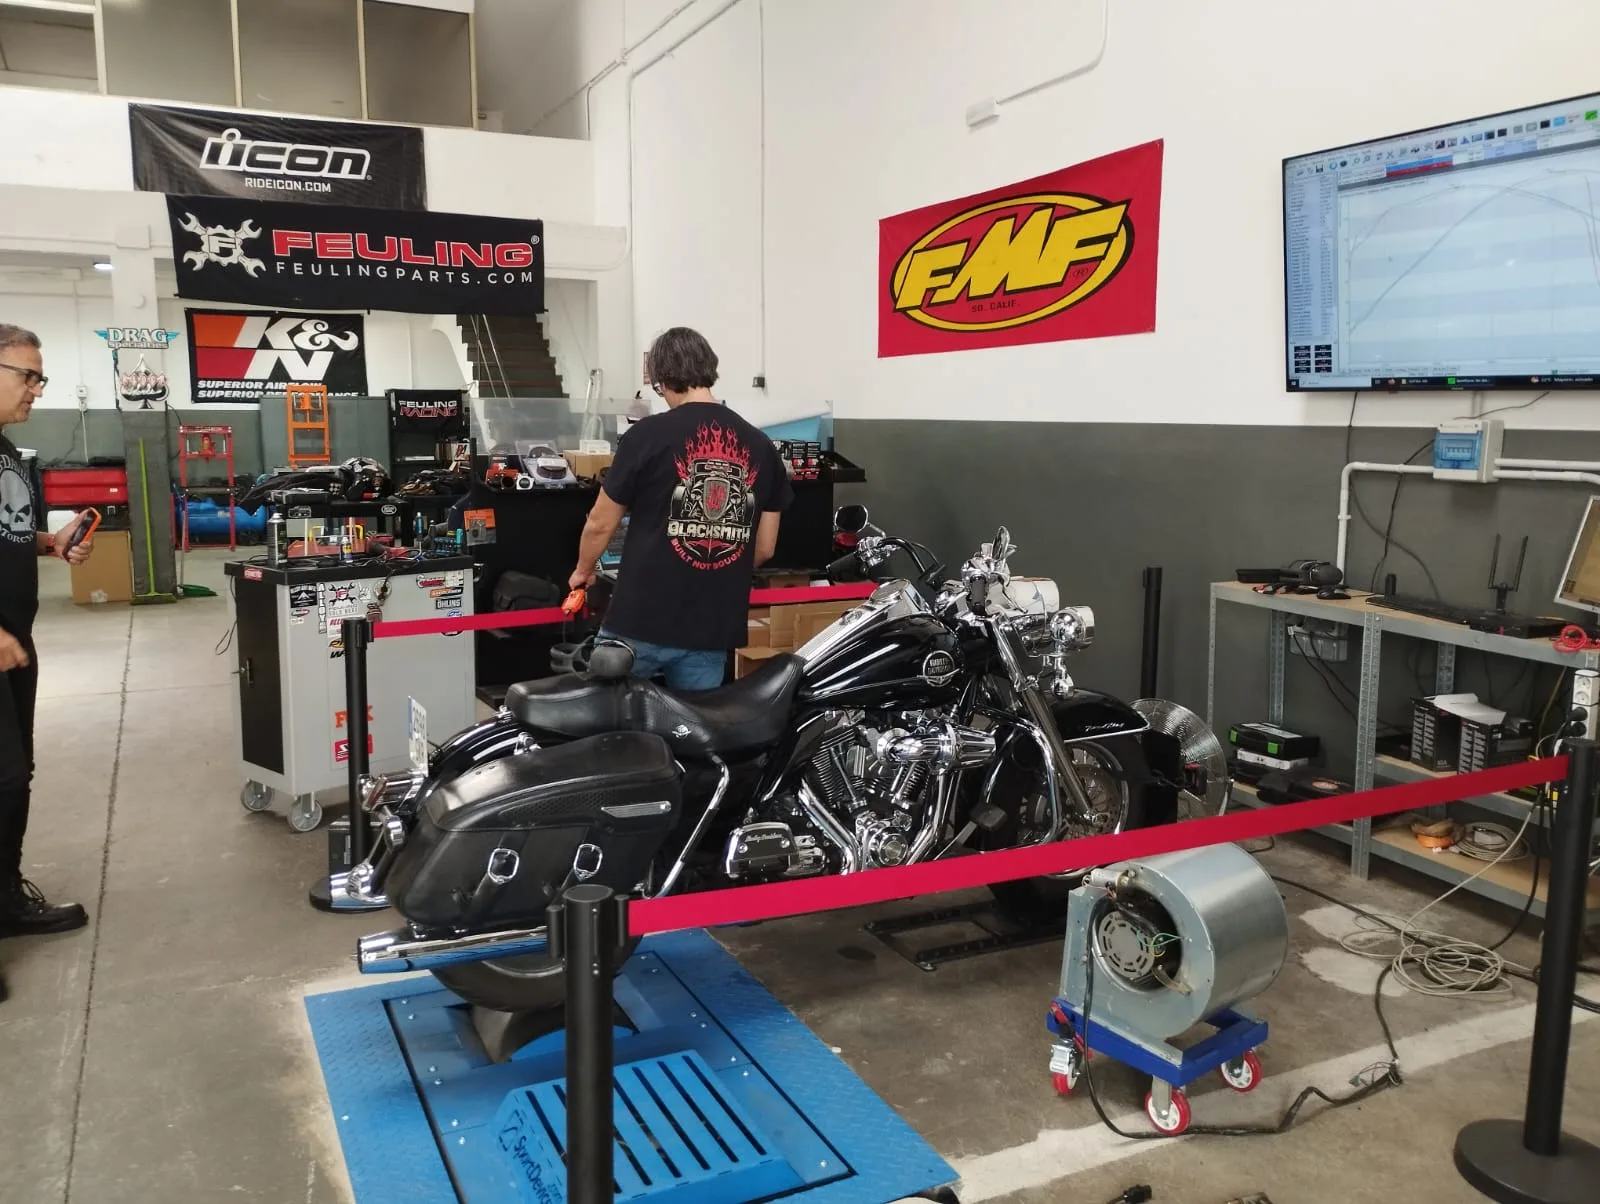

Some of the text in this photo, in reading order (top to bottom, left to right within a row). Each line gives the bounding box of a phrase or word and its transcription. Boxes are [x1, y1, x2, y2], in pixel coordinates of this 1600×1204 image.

[244, 177, 332, 193] RIDEICON.COM
[893, 199, 1132, 313] FMF
[276, 261, 533, 285] FEULINGPARTS.COM
[107, 327, 168, 343] DRAG
[197, 380, 264, 390] SUPERIOR
[197, 390, 264, 398] SUPERIOR
[399, 400, 457, 408] FEULING
[400, 406, 457, 418] RACING
[671, 538, 692, 563] BUILT
[691, 560, 712, 570] NOT
